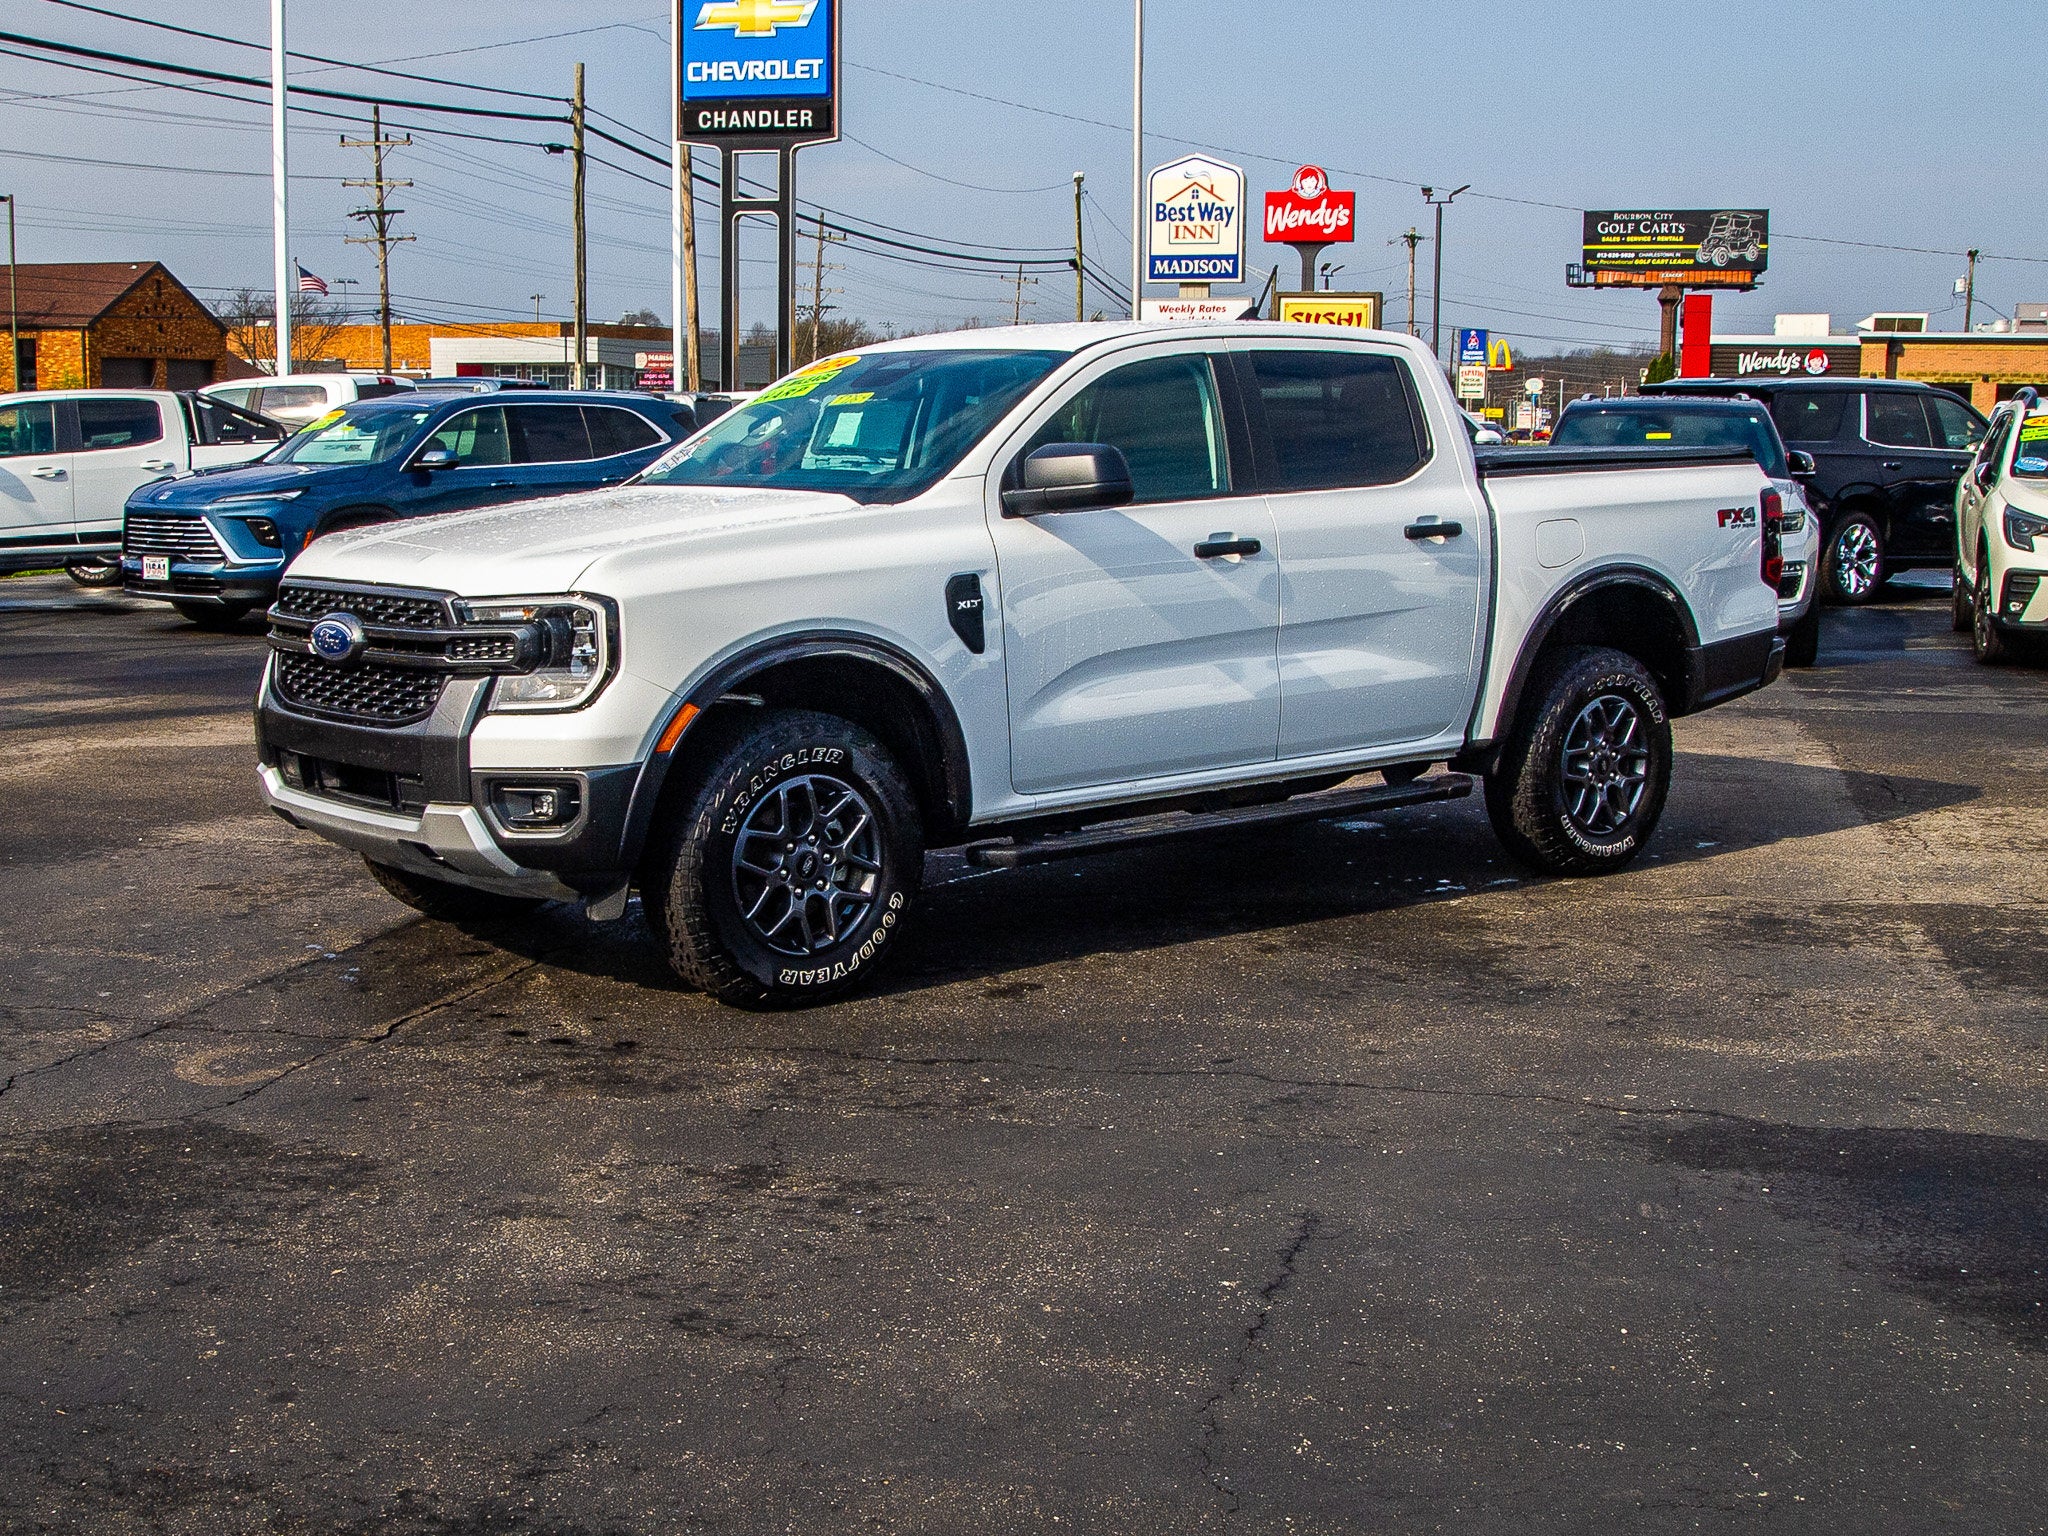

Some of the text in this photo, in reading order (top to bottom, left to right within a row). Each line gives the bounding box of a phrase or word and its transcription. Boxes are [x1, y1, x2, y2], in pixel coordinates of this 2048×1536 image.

[687, 58, 824, 82] CHEVROLET
[697, 110, 813, 128] CHANDLER
[1155, 202, 1235, 227] Best Way
[1266, 198, 1350, 235] Wendy's
[1654, 213, 1674, 221] CITY
[1173, 224, 1214, 240] INN
[1597, 221, 1686, 234] GOLF CARTS
[1154, 259, 1234, 274] MADISON
[1159, 304, 1227, 315] Weekly Rates
[1291, 312, 1363, 327] SUSHI
[1738, 348, 1801, 375] Wendy's
[1717, 506, 1757, 528] FX4
[721, 747, 845, 835] WRANGLER
[1560, 814, 1636, 857] WRANGLER
[779, 891, 904, 985] GOODYEAR
